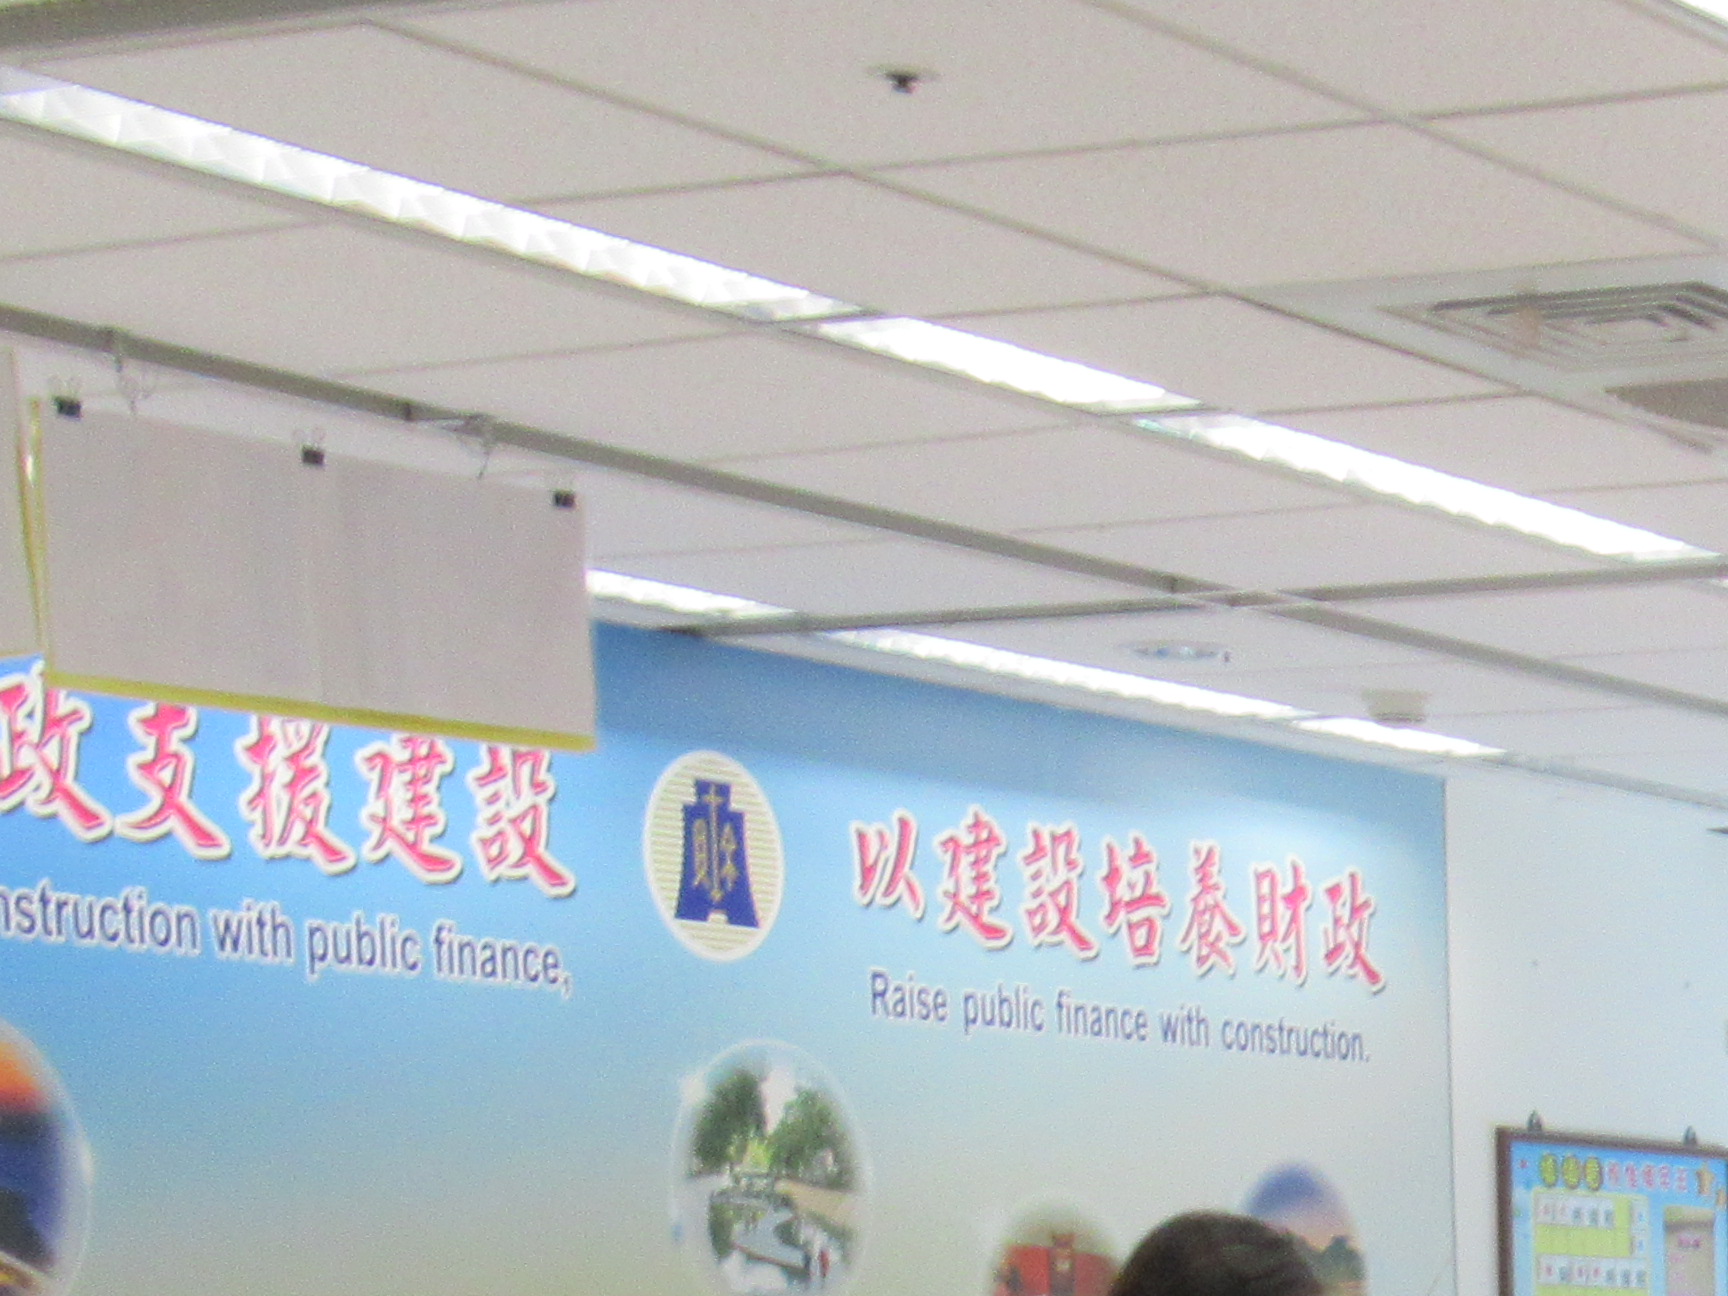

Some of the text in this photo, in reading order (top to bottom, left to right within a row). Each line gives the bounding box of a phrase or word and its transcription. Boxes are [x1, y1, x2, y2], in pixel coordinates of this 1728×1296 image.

[0, 683, 573, 892] 政支援建設
[212, 902, 293, 960] with
[307, 910, 420, 980] public
[432, 921, 570, 995] finance,
[852, 812, 1384, 989] 以建設培養財政
[869, 969, 1371, 1063] Raise public finance with construction.
